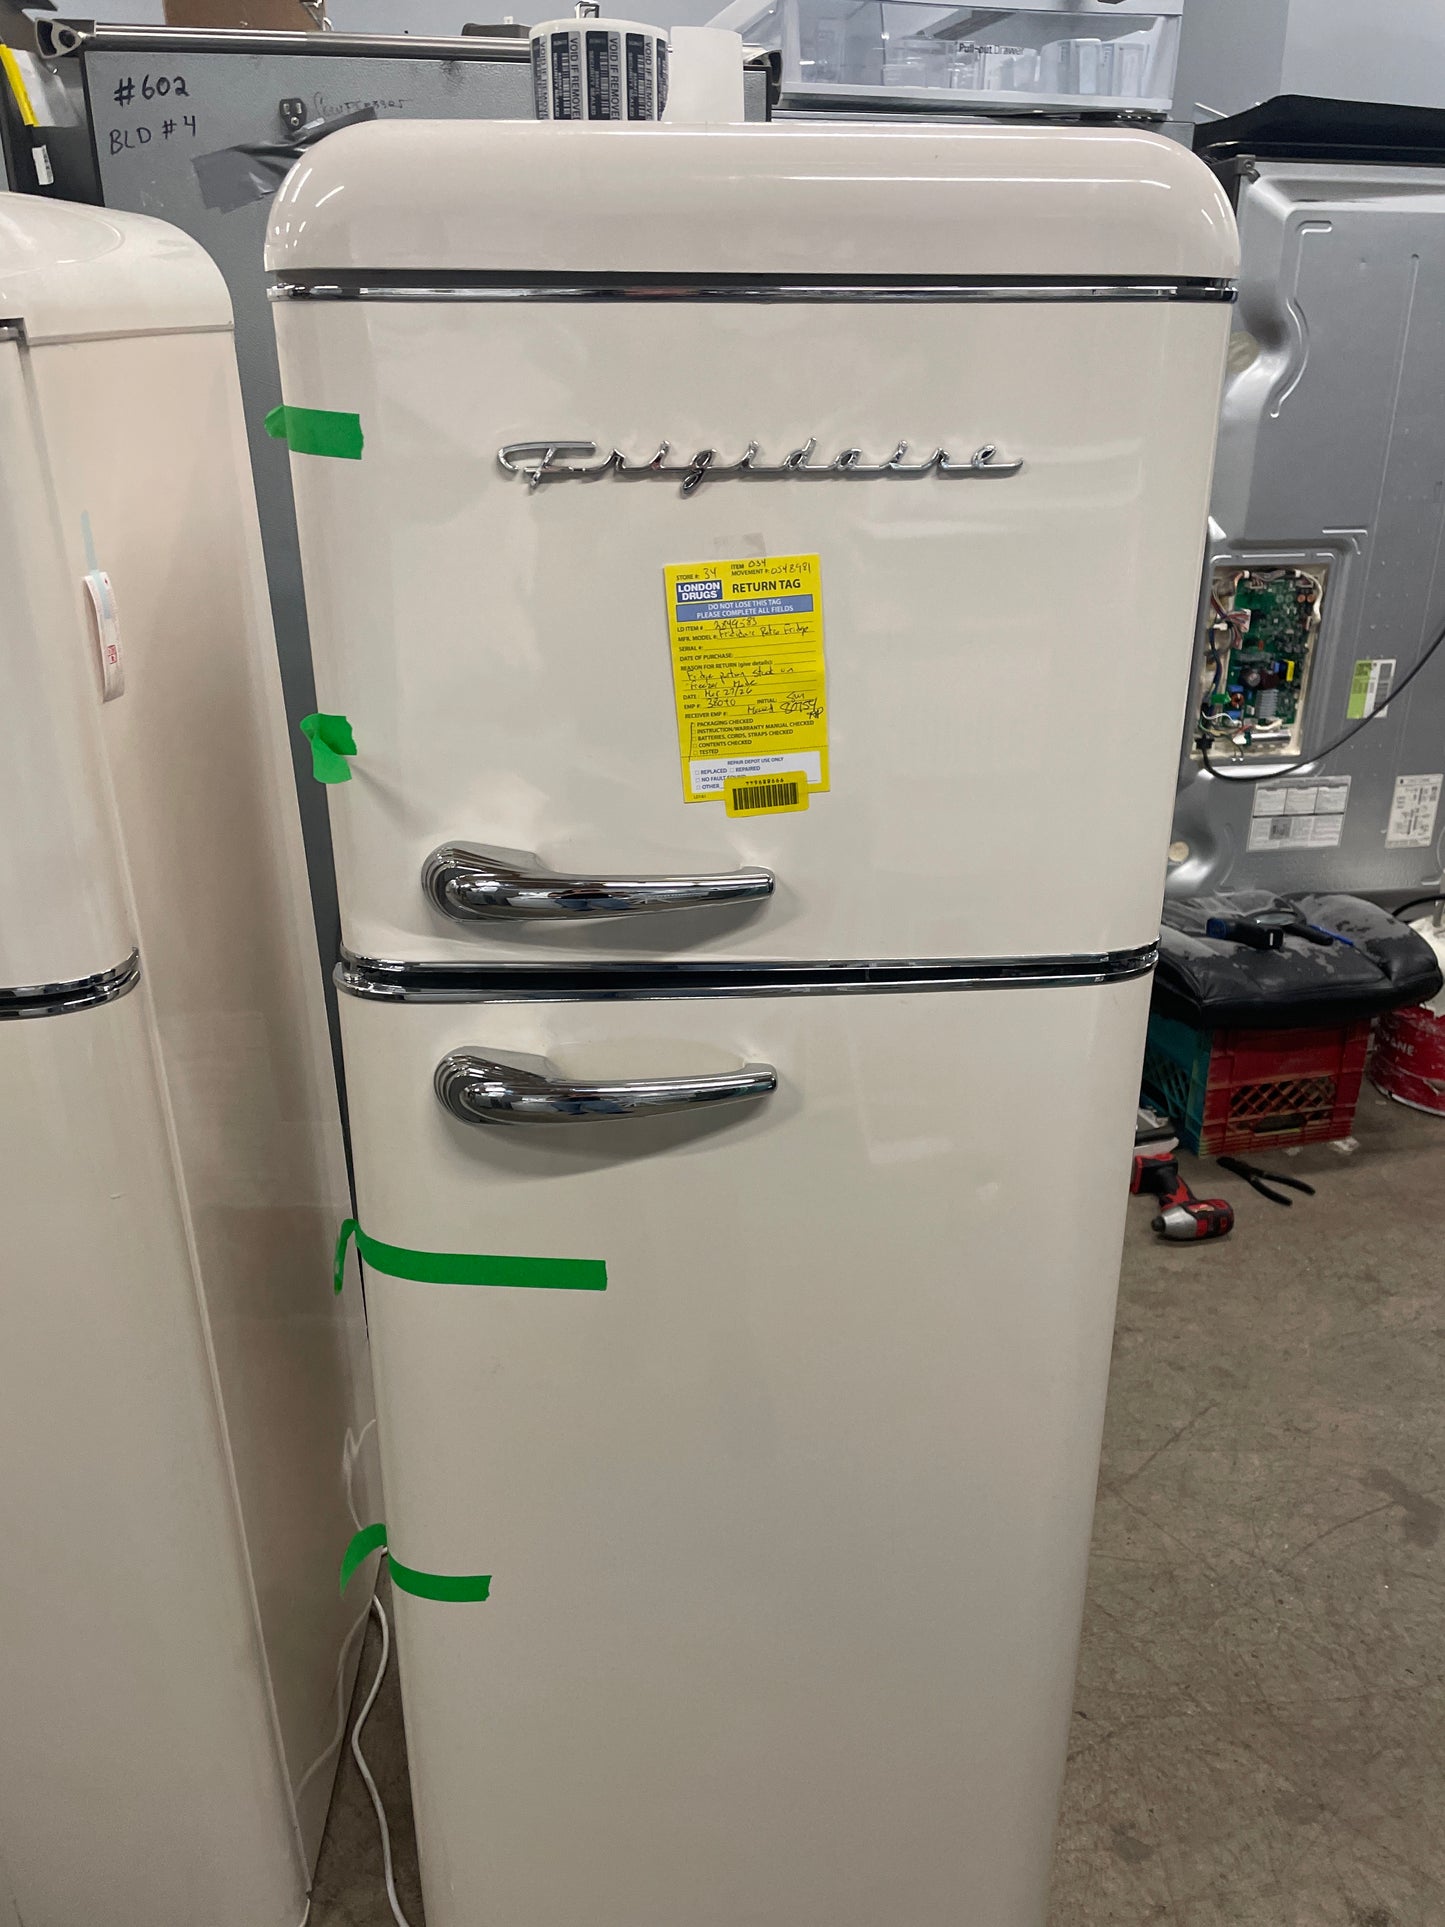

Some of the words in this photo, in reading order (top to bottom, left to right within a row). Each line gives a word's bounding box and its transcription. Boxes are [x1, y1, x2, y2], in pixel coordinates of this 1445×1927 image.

[570, 38, 579, 62] VOID
[609, 38, 618, 62] VOID
[570, 64, 580, 73] IF
[609, 64, 619, 73] IF
[114, 74, 190, 107] #602
[109, 126, 151, 155] BLD
[497, 437, 1024, 498] Frigidaire
[703, 567, 718, 580] 34
[677, 582, 721, 593] LONDON
[732, 581, 777, 593] RETURN
[778, 579, 801, 589] TAG
[681, 590, 719, 601] DRUGS
[708, 603, 719, 611] DO
[719, 602, 733, 610] NOT
[734, 601, 751, 609] LOSE
[767, 598, 782, 606] TAG
[696, 610, 721, 619] PLEASE
[721, 608, 755, 617] COMPLETE
[757, 606, 771, 615] ALL
[771, 605, 794, 613] FIELDS
[681, 664, 703, 672] REASON
[789, 719, 815, 727] CHECKED
[747, 730, 768, 738] STRAPS
[768, 728, 794, 736] CHECKED
[698, 740, 727, 748] CONTENTS
[700, 767, 728, 775] REPLACED
[735, 765, 761, 773] REPAIRED
